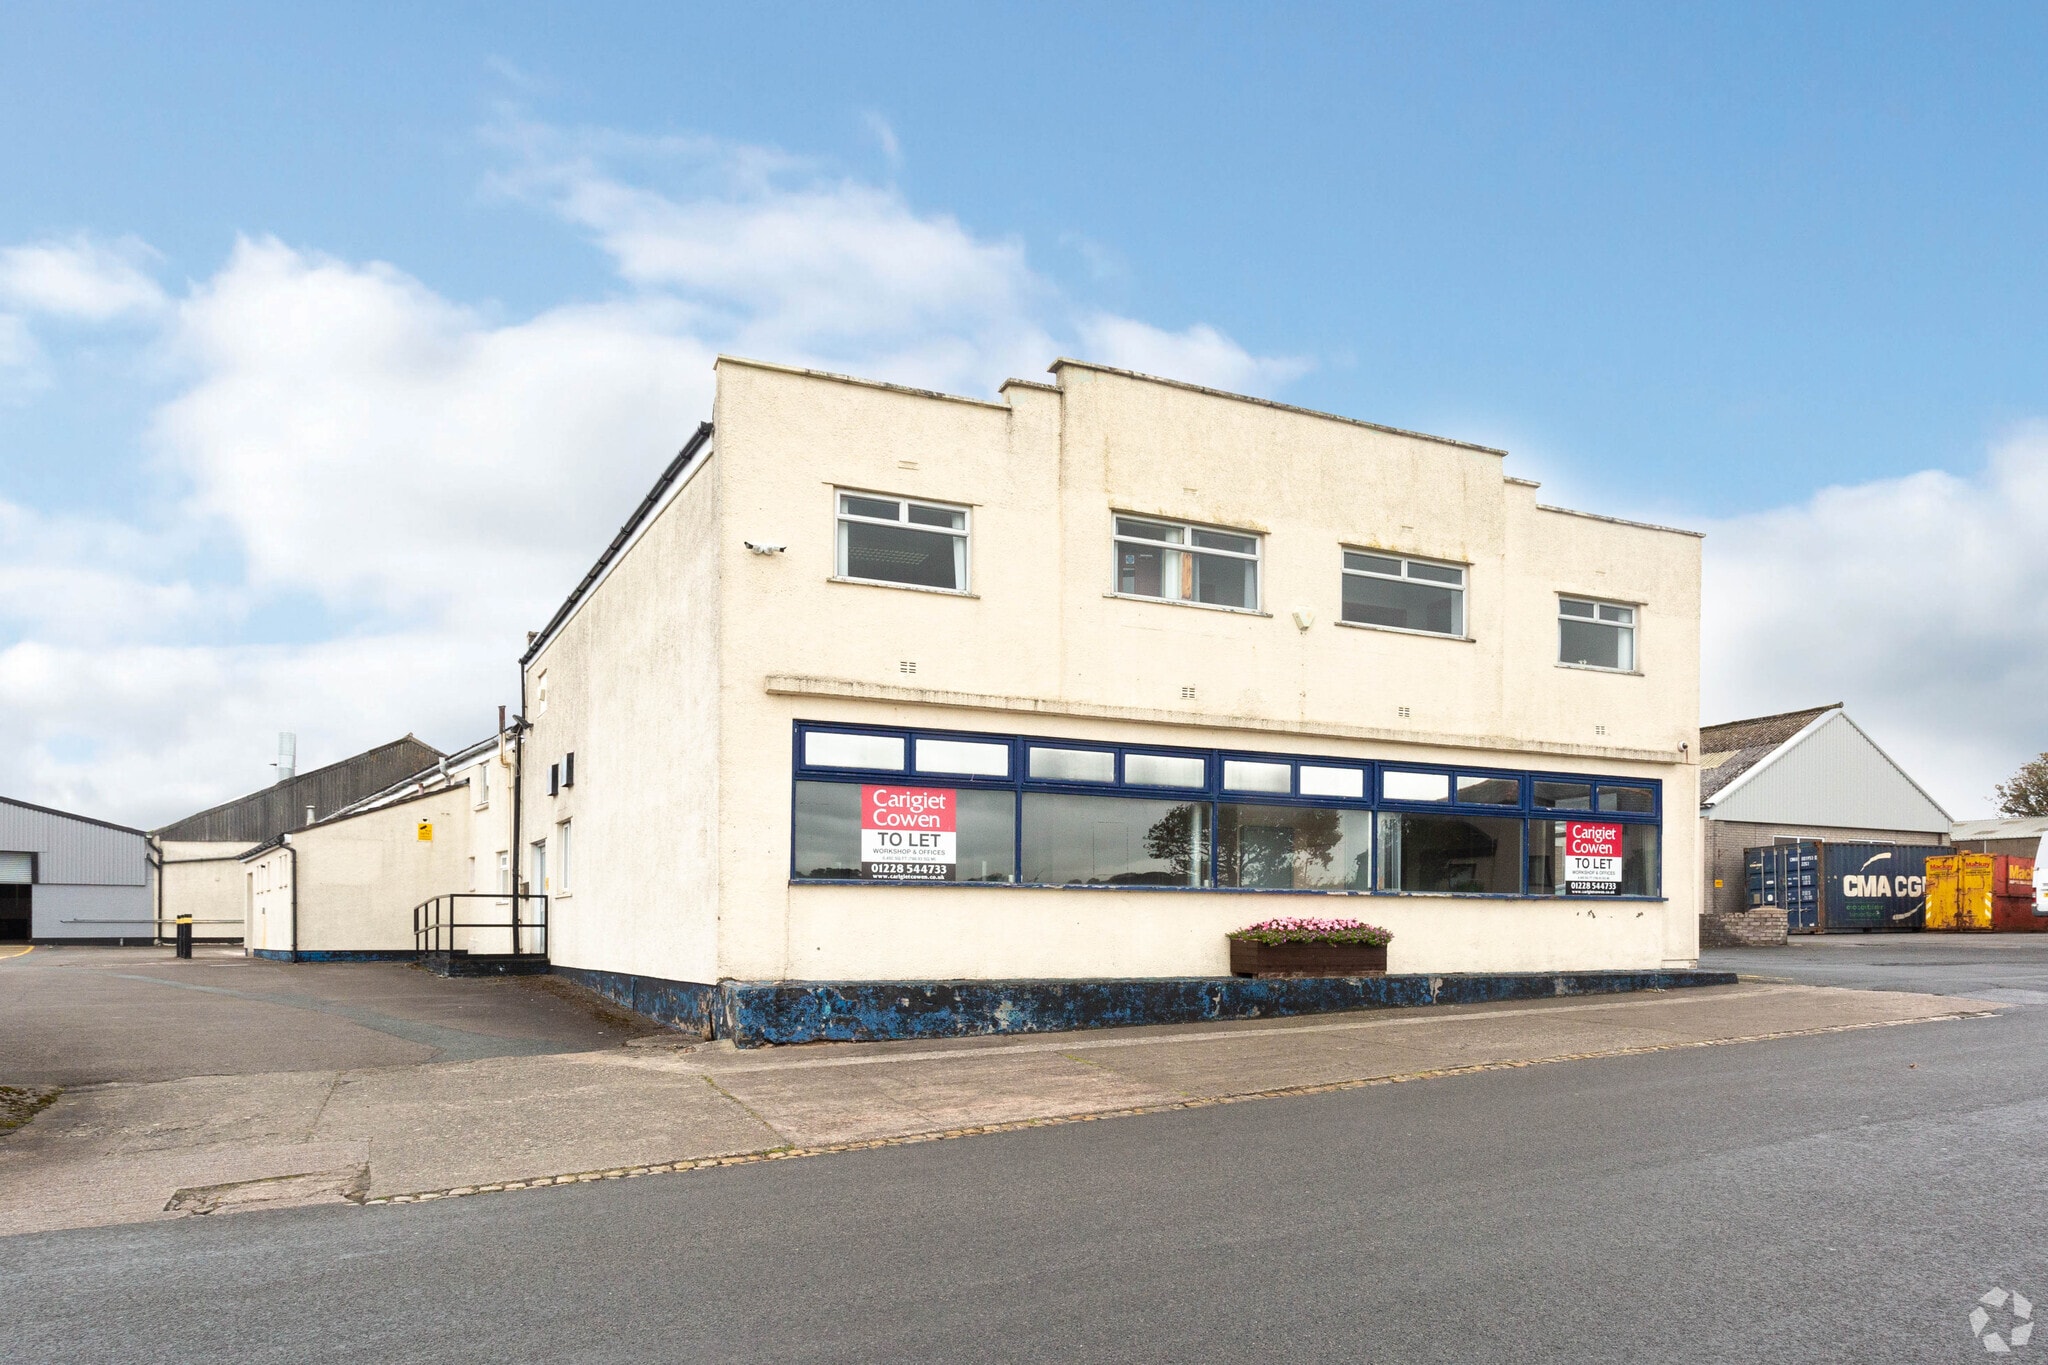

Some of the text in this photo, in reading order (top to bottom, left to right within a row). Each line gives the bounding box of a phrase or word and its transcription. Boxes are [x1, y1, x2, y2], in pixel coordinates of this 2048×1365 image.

[873, 789, 946, 813] Carigiet
[873, 808, 940, 828] Cowen
[878, 832, 941, 848] TO LET
[1572, 825, 1617, 843] Carigiet
[1572, 839, 1613, 854] Cowen
[871, 863, 947, 874] 01228 544733
[1575, 858, 1613, 870] TO LET
[1571, 881, 1617, 890] 01228 544733
[1843, 874, 1892, 897] CMA
